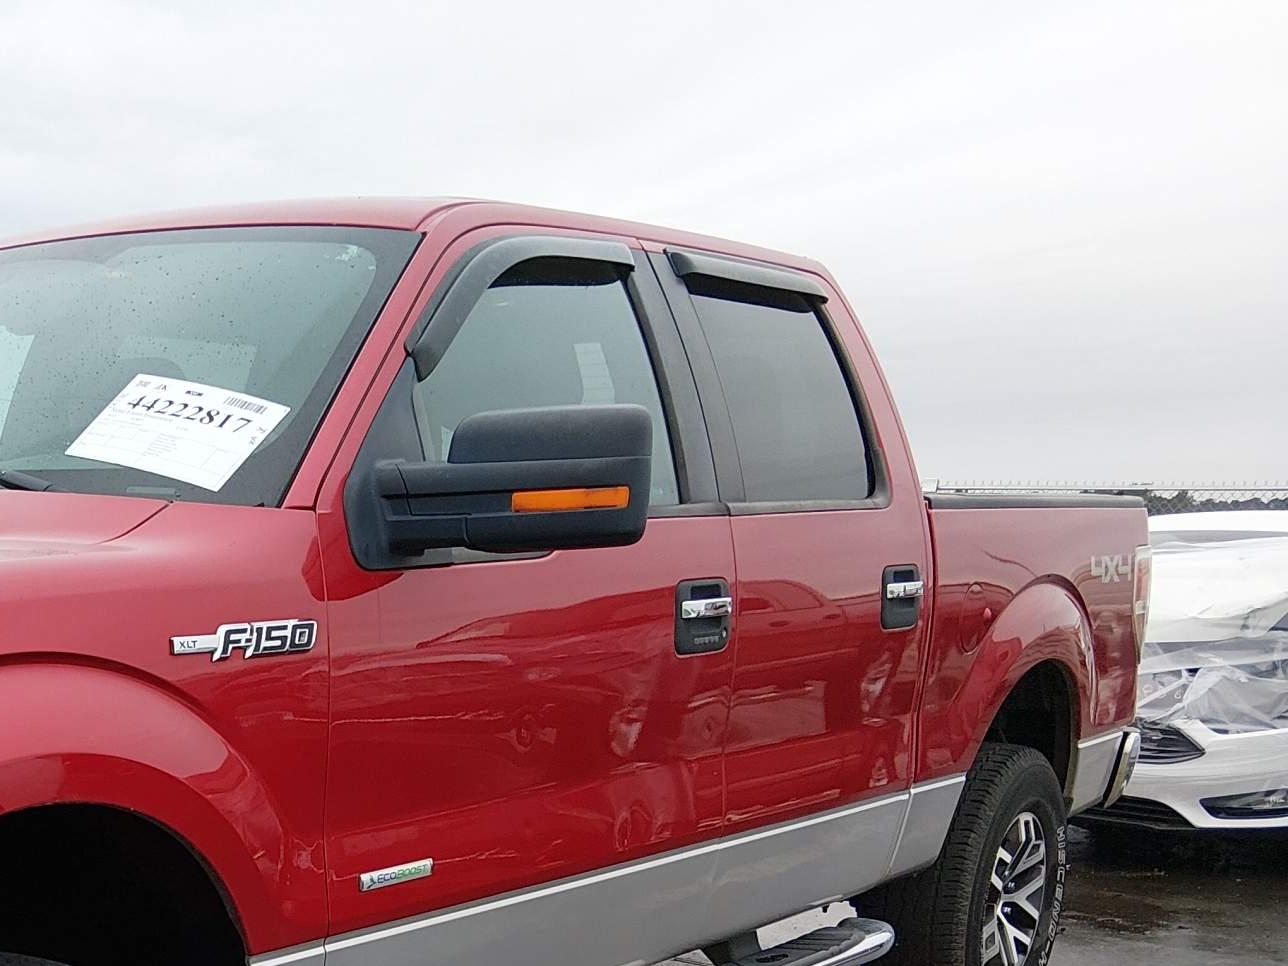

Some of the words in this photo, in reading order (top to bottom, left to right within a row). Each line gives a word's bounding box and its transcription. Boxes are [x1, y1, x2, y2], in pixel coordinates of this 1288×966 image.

[127, 395, 253, 432] 44222817
[179, 640, 198, 649] XLT
[214, 619, 318, 660] F-150
[377, 864, 430, 884] ECOBOOST
